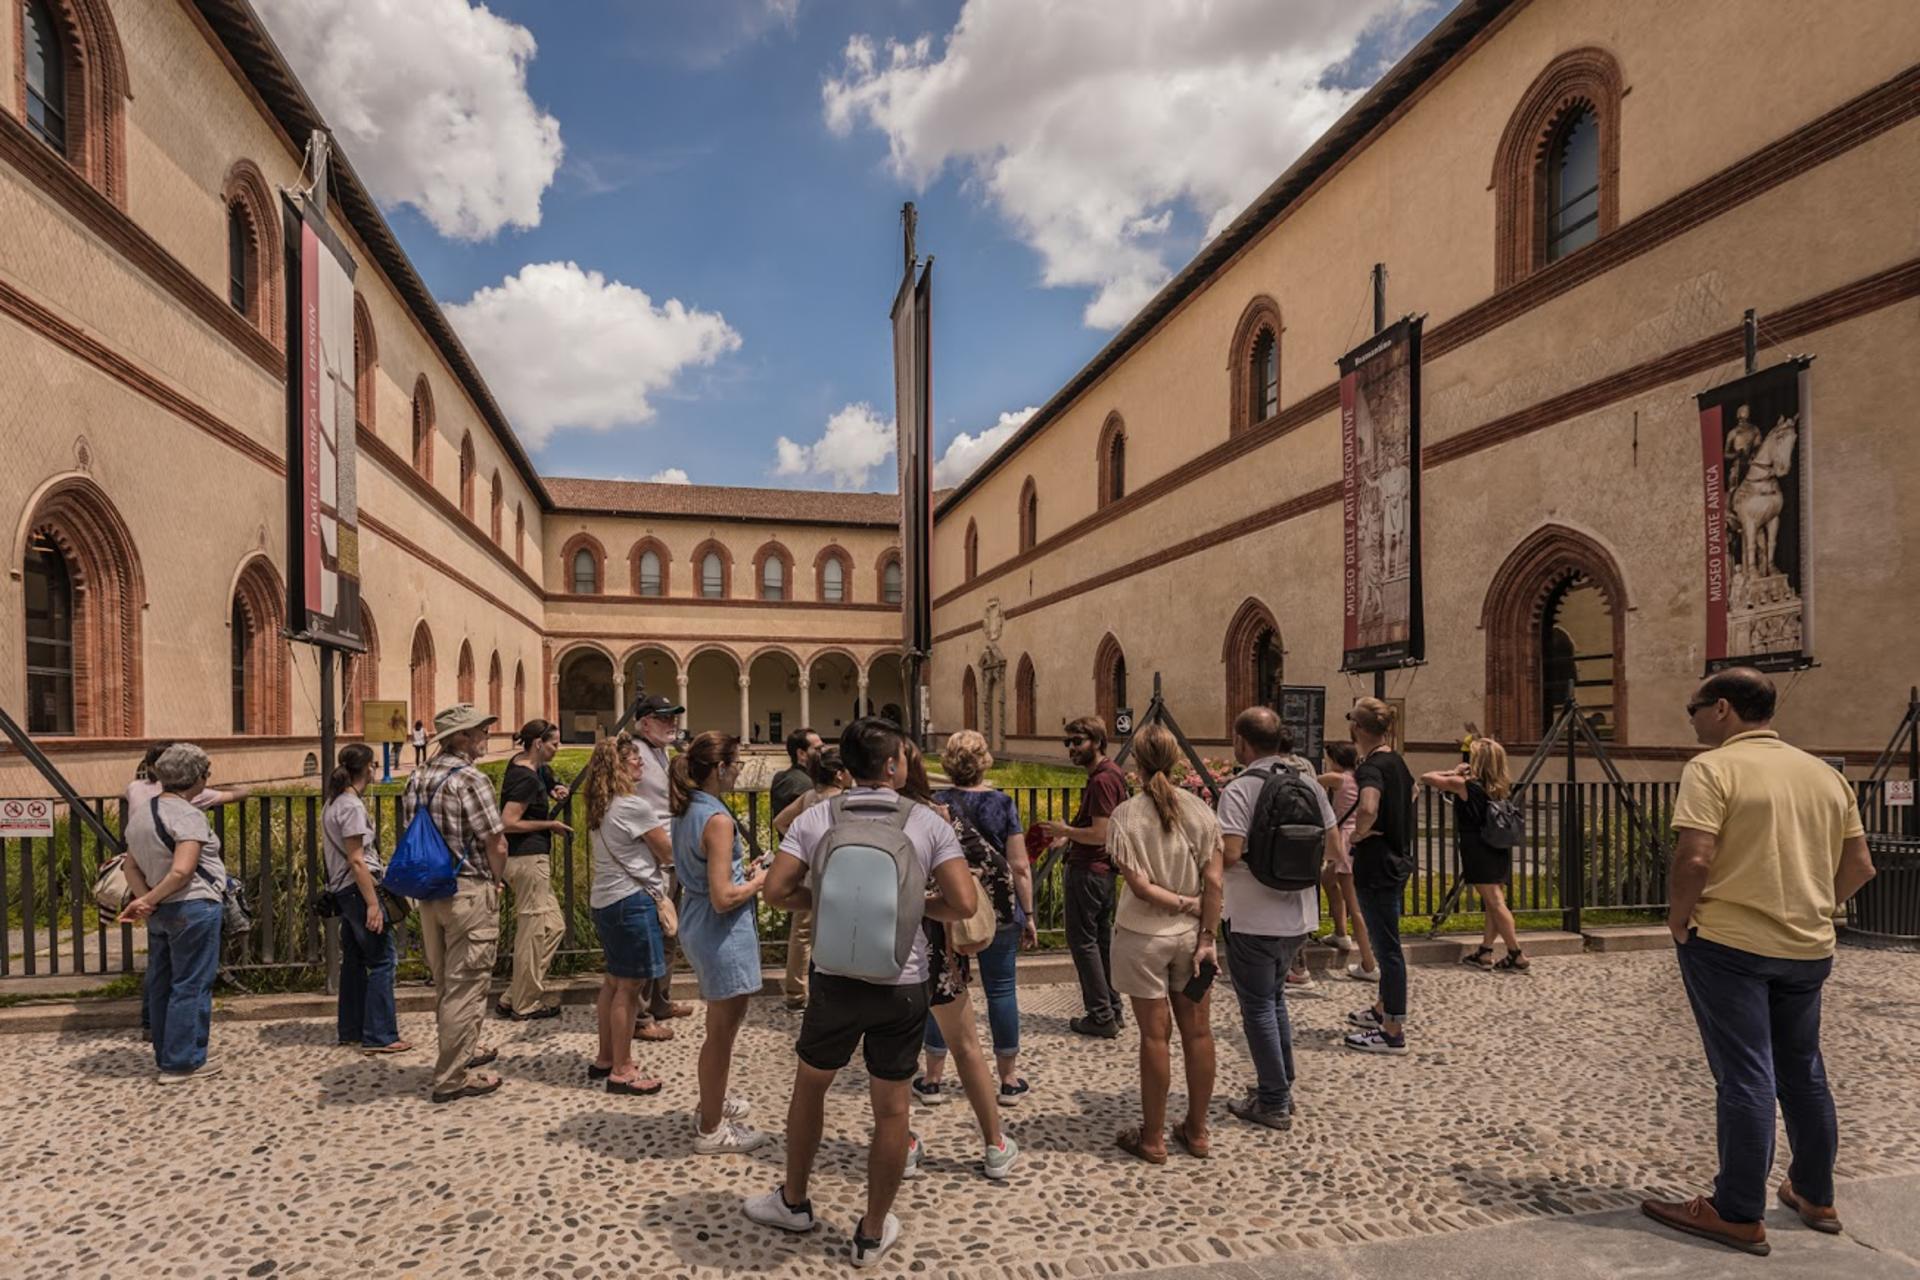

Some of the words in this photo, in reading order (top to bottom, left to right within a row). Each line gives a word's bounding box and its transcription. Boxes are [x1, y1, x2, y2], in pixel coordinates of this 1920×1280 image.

[308, 302, 317, 372] DESIGN
[309, 379, 318, 400] AL
[309, 407, 318, 475] SFORZA
[1343, 408, 1355, 489] DECORATIVE
[310, 481, 319, 537] DAGLI
[1344, 492, 1355, 521] ARTI
[1706, 464, 1720, 509] ANTICA
[1345, 524, 1356, 565] DELLE
[1708, 511, 1721, 556] D'ARTE
[1346, 568, 1356, 617] MUSEO
[1709, 558, 1722, 602] MUSEO
